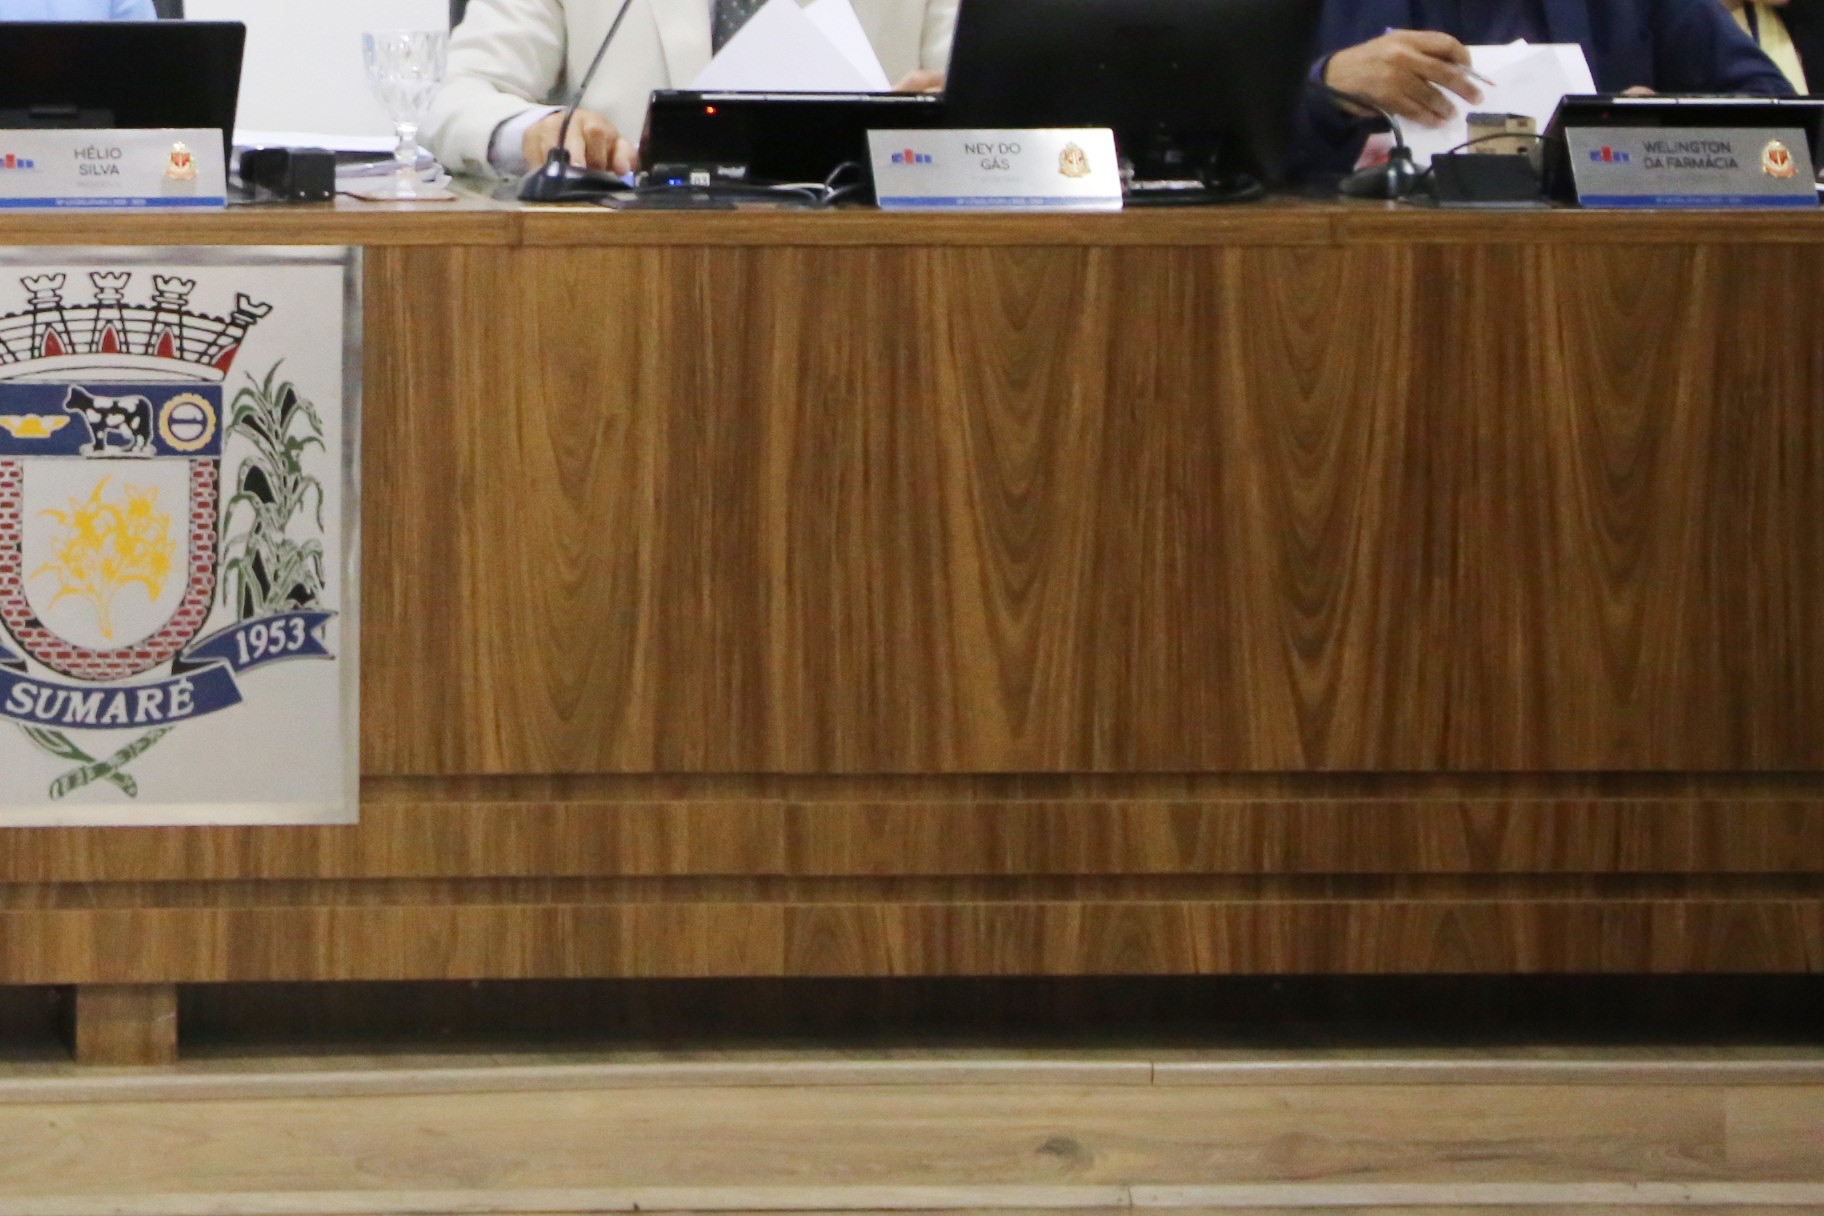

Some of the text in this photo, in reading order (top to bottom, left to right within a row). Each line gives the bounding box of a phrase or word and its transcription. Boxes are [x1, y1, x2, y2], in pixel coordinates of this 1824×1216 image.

[74, 145, 123, 160] HÉLIO
[964, 143, 1022, 155] NEY DO
[1642, 140, 1731, 154] WELINGTON
[980, 156, 1011, 171] GÁS
[1644, 153, 1739, 170] DA FARMÁCIA
[78, 163, 120, 176] SILVA
[5, 677, 195, 724] SUMARÉ
[236, 618, 307, 665] 1953
